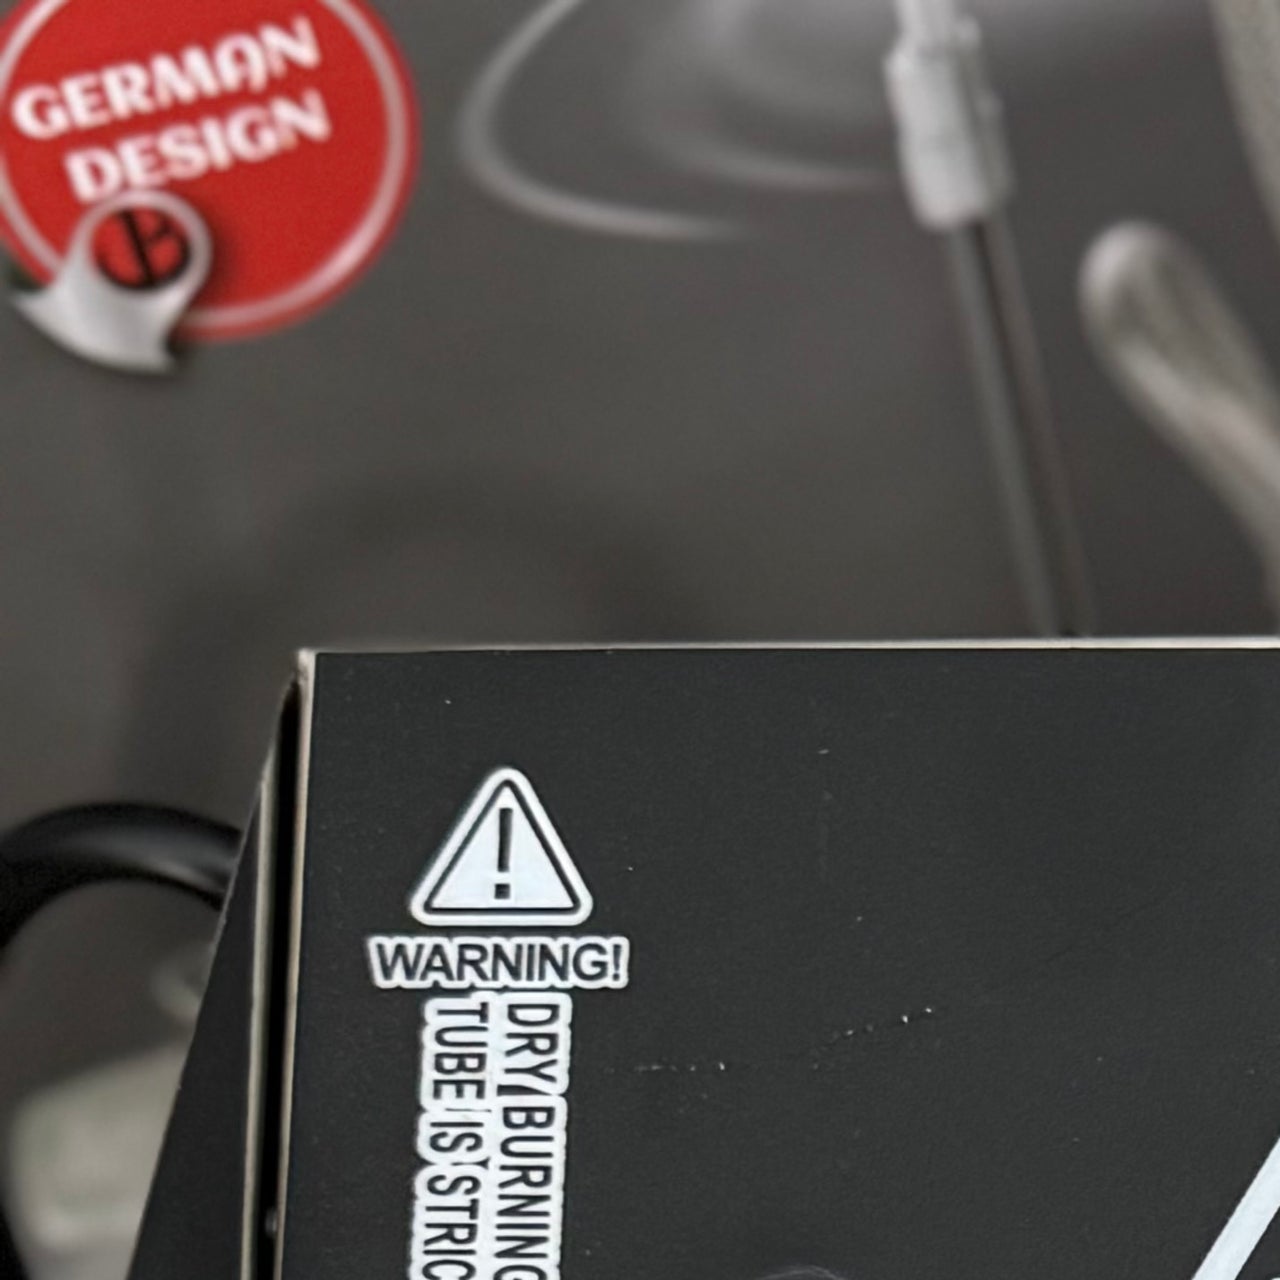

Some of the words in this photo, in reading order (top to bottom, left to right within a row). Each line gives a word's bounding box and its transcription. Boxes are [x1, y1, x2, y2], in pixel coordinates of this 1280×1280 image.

[11, 14, 322, 140] GERMAN
[63, 88, 332, 205] DESIGN
[374, 942, 624, 983] WARNING!
[431, 1001, 490, 1100] TUBE
[503, 1003, 561, 1084] DRY
[428, 1120, 485, 1154] IS
